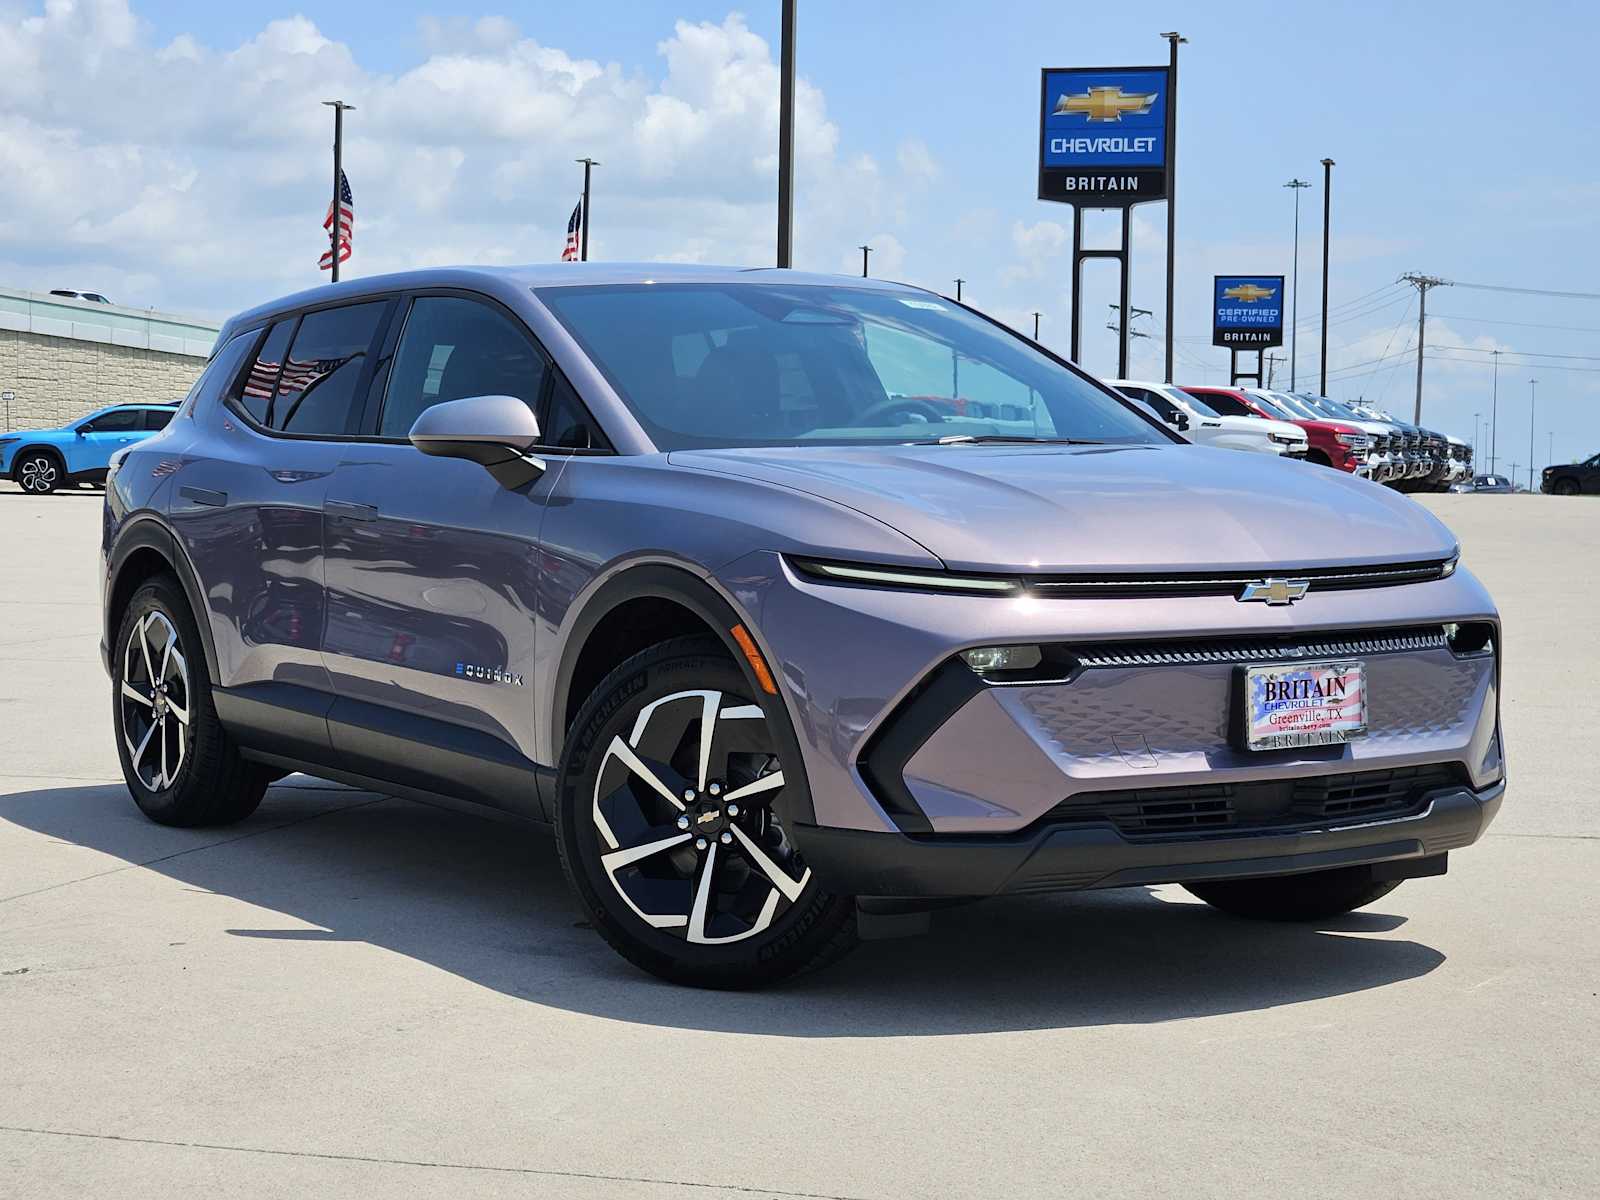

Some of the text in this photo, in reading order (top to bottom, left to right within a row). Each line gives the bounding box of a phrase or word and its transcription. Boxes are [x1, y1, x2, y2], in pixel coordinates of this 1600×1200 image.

[1050, 137, 1156, 153] CHEVROLET
[1065, 176, 1138, 191] BRITAIN
[1217, 308, 1279, 316] CERTIFIED
[1220, 315, 1275, 323] PRE-OWNED
[1224, 333, 1271, 341] BRITAIN
[455, 663, 523, 686] EQUINOX
[1265, 676, 1347, 702] BRITAIN
[1264, 698, 1324, 711] CHEVROLET
[1269, 707, 1343, 725] Greenville, TX
[1273, 730, 1346, 748] BRITAIN
